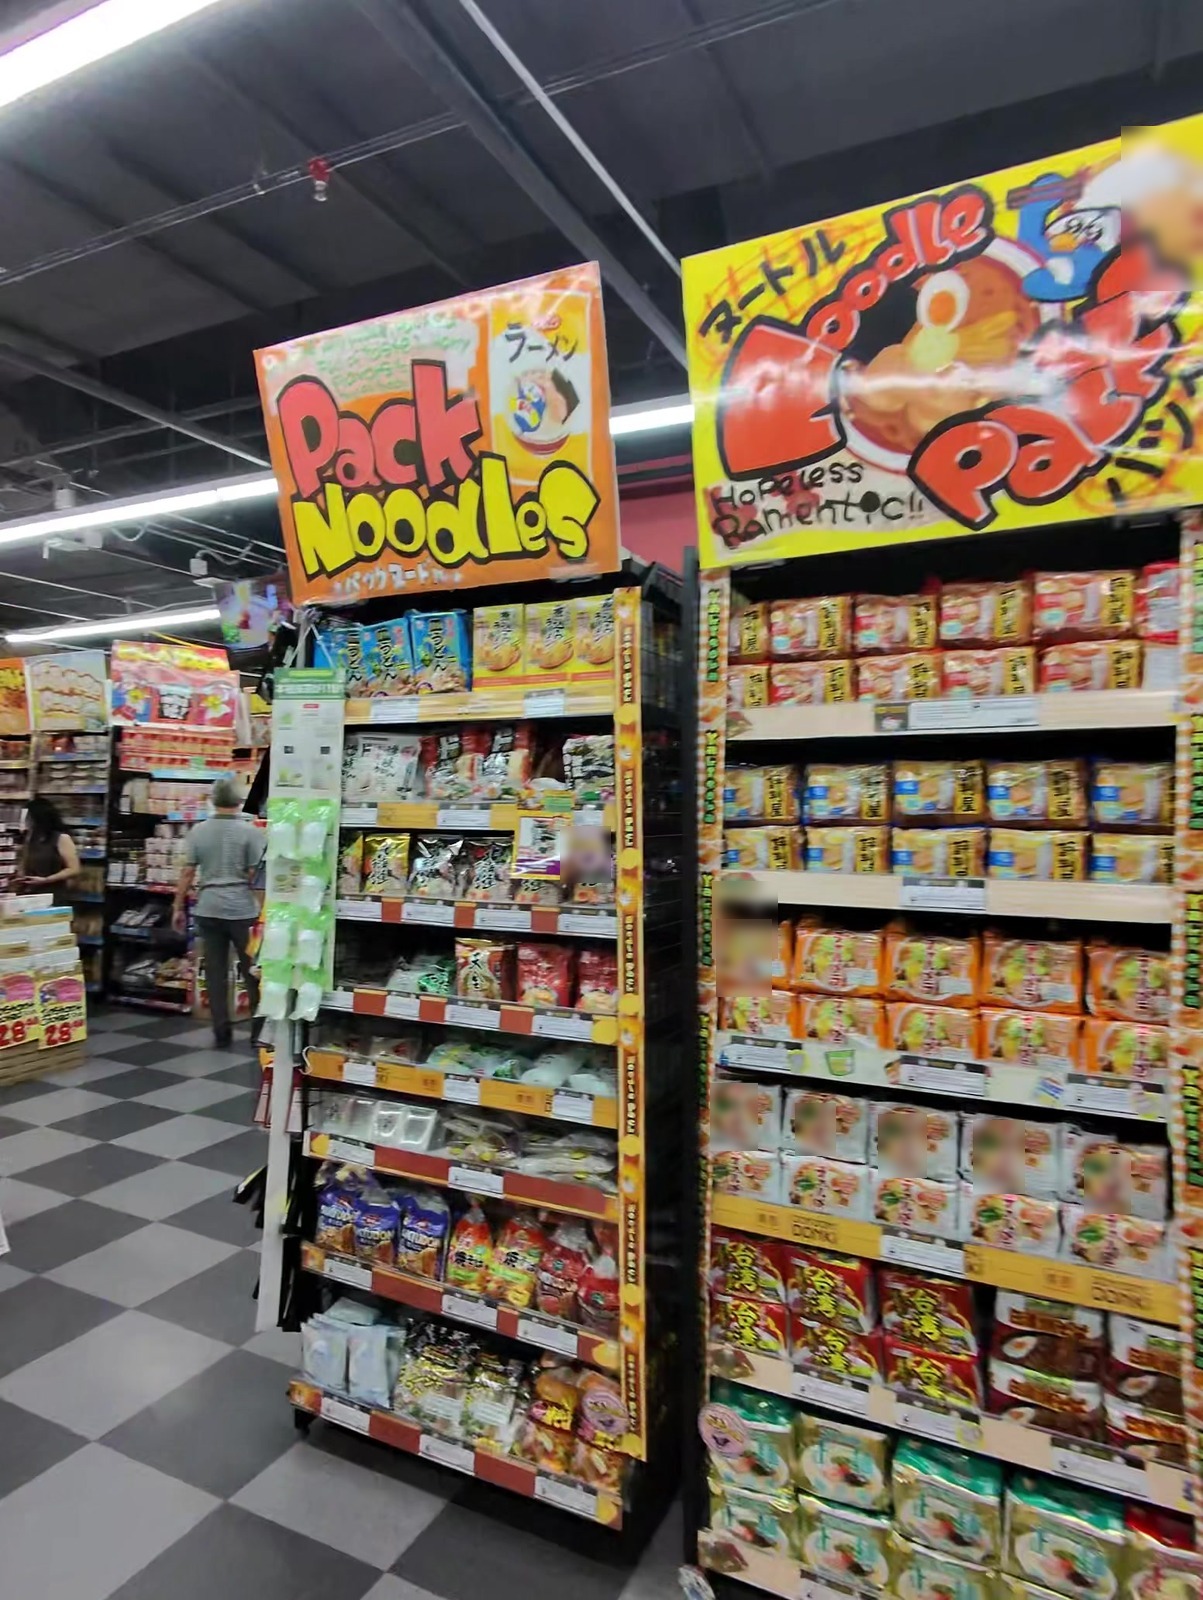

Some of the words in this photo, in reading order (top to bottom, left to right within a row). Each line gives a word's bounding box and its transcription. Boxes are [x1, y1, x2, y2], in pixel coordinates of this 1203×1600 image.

[504, 321, 579, 363] ラーメン
[277, 359, 483, 500] Pack
[291, 451, 601, 581] Noodles
[710, 461, 864, 517] Hopeless
